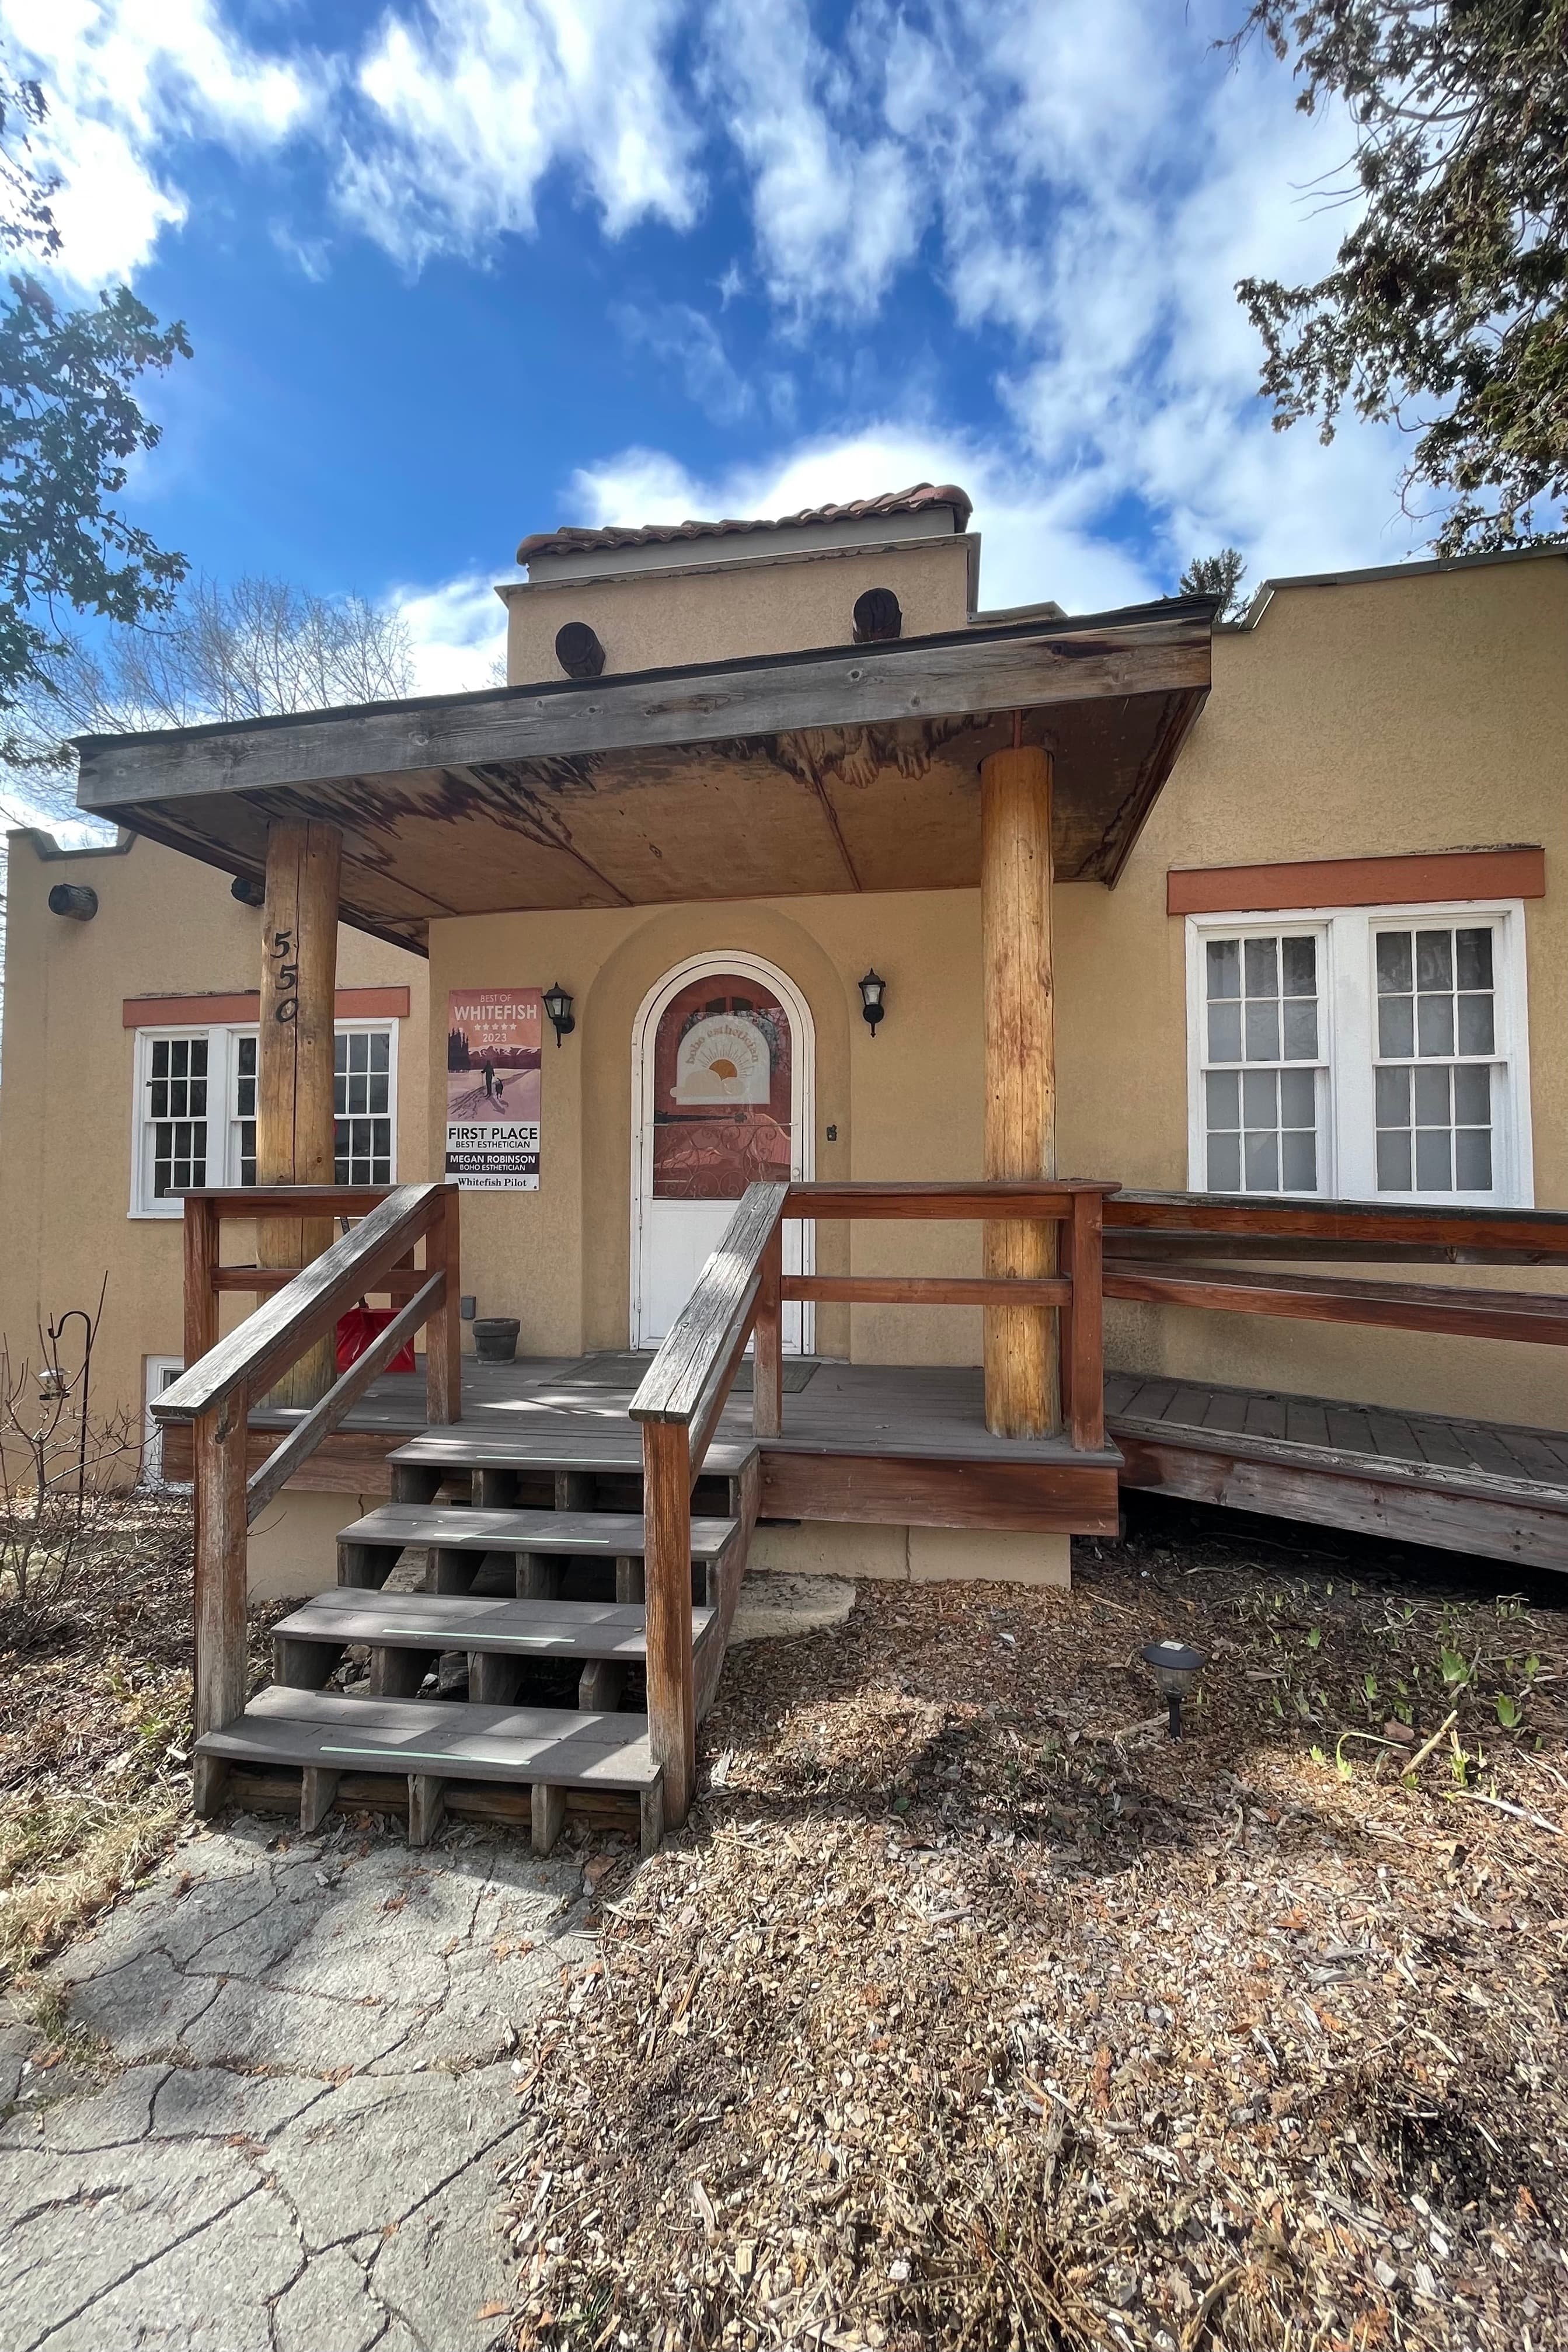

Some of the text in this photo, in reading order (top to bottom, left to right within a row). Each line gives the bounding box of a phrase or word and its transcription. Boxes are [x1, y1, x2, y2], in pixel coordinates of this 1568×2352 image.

[270, 931, 299, 1023] 550
[480, 994, 513, 1003] BEST OF
[454, 1004, 537, 1021] WHITEFISH
[483, 1033, 507, 1042] 2023
[448, 1127, 538, 1140] FIRST PLACE
[450, 1155, 535, 1163] MEGAN ROBINSON
[458, 1177, 527, 1187] Whitefish Pilot
